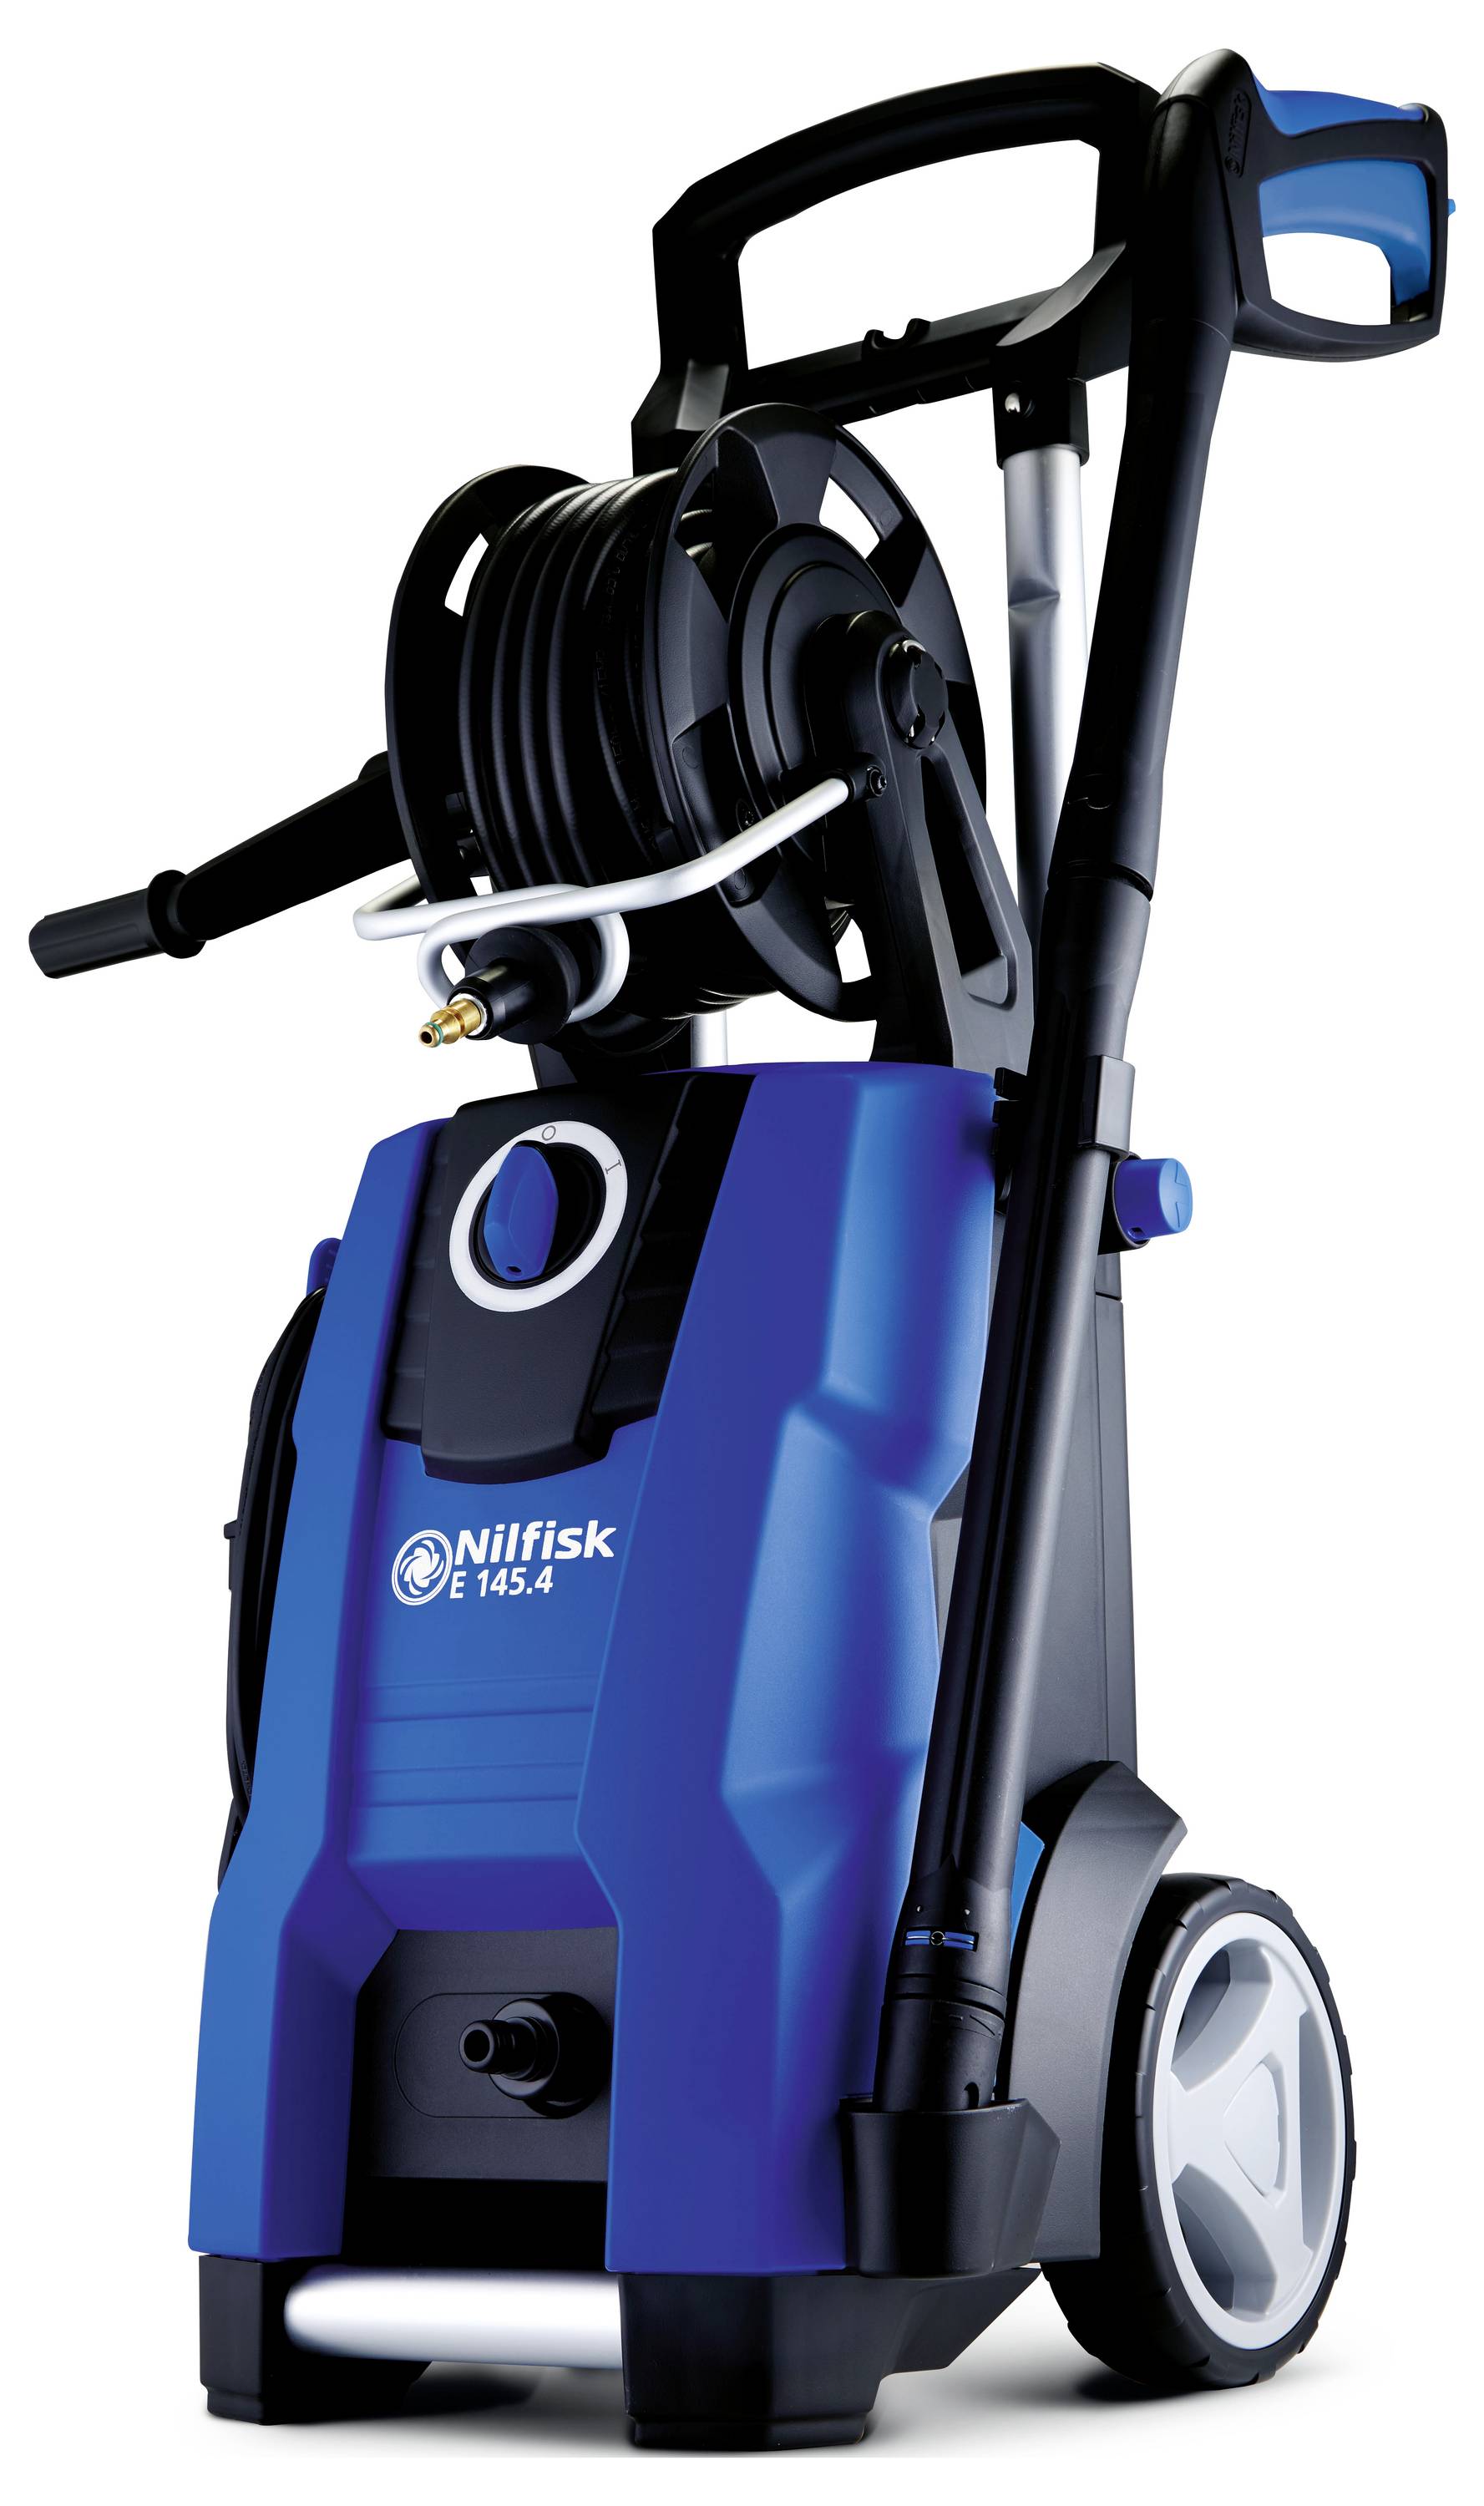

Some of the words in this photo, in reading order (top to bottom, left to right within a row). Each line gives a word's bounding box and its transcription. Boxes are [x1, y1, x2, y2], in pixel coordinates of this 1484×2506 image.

[454, 1519, 617, 1566] Nilfisk
[449, 1570, 467, 1599] E
[477, 1565, 554, 1597] 145.4
